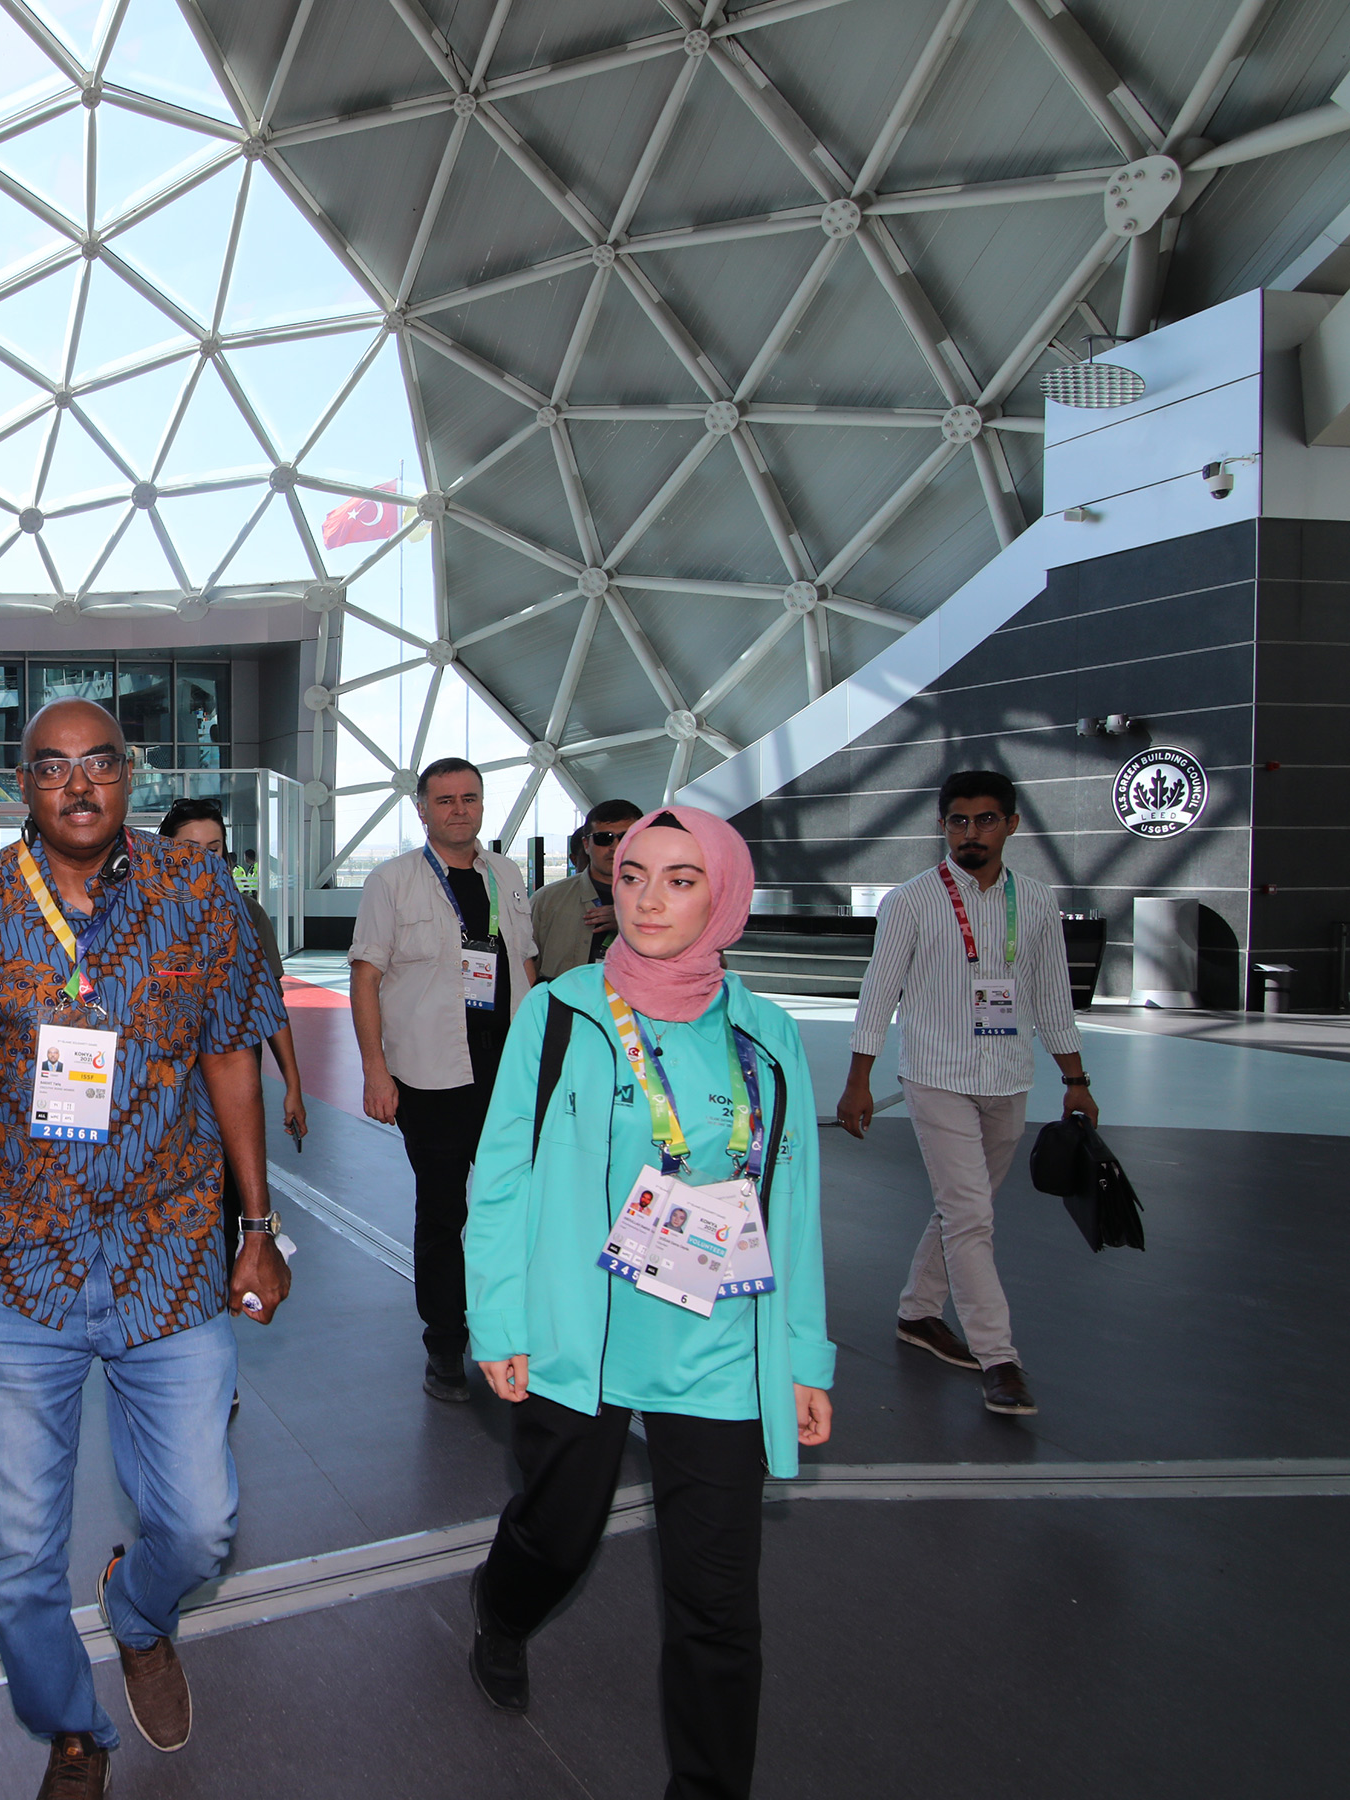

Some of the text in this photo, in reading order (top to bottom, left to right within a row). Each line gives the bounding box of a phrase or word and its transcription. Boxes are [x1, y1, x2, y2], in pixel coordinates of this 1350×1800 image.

[1118, 762, 1141, 793] GREEN
[1140, 752, 1188, 767] BUILDING
[1186, 766, 1202, 808] COUNCIL
[1141, 812, 1177, 820] LEED
[1140, 822, 1177, 834] USGBC
[689, 1237, 726, 1256] VOLUNTEER
[681, 1294, 688, 1304] 6
